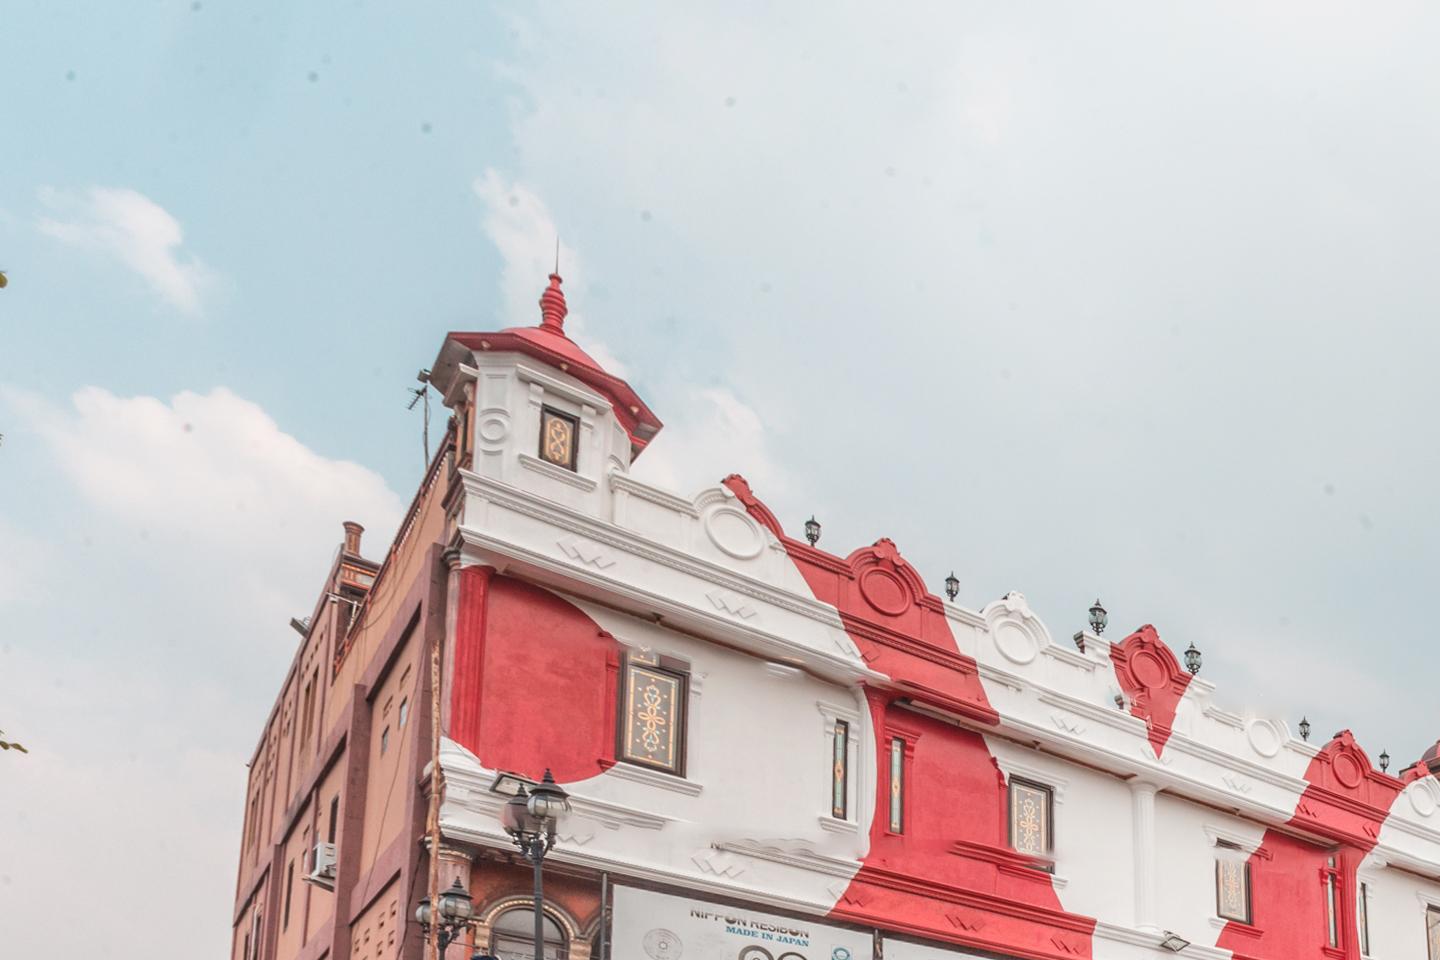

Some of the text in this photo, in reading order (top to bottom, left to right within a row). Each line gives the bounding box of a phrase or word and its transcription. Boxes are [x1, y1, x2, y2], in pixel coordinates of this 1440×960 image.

[726, 926, 809, 947] MADE IN JAPAN
